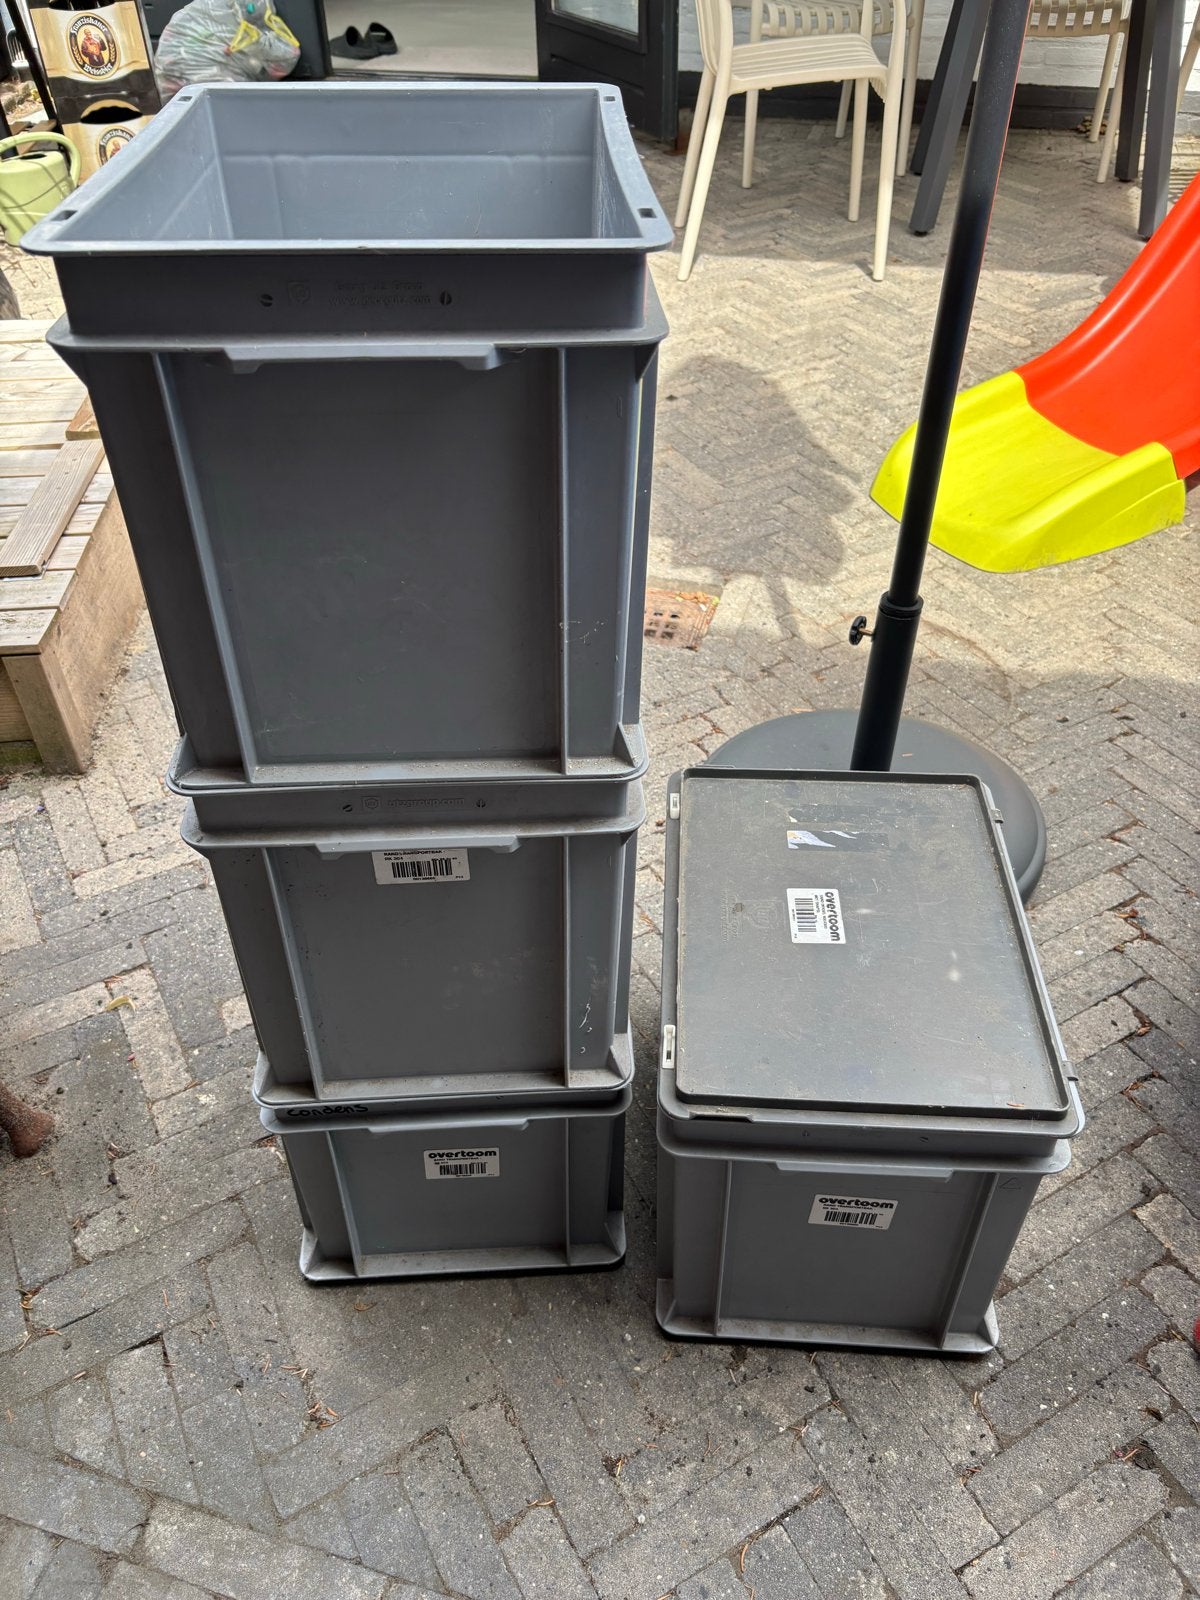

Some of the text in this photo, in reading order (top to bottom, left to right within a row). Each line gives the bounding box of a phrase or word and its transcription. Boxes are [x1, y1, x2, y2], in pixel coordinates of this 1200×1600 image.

[824, 891, 841, 942] overtoom
[428, 1150, 497, 1159] overtoom
[818, 1197, 894, 1209] overtoom
